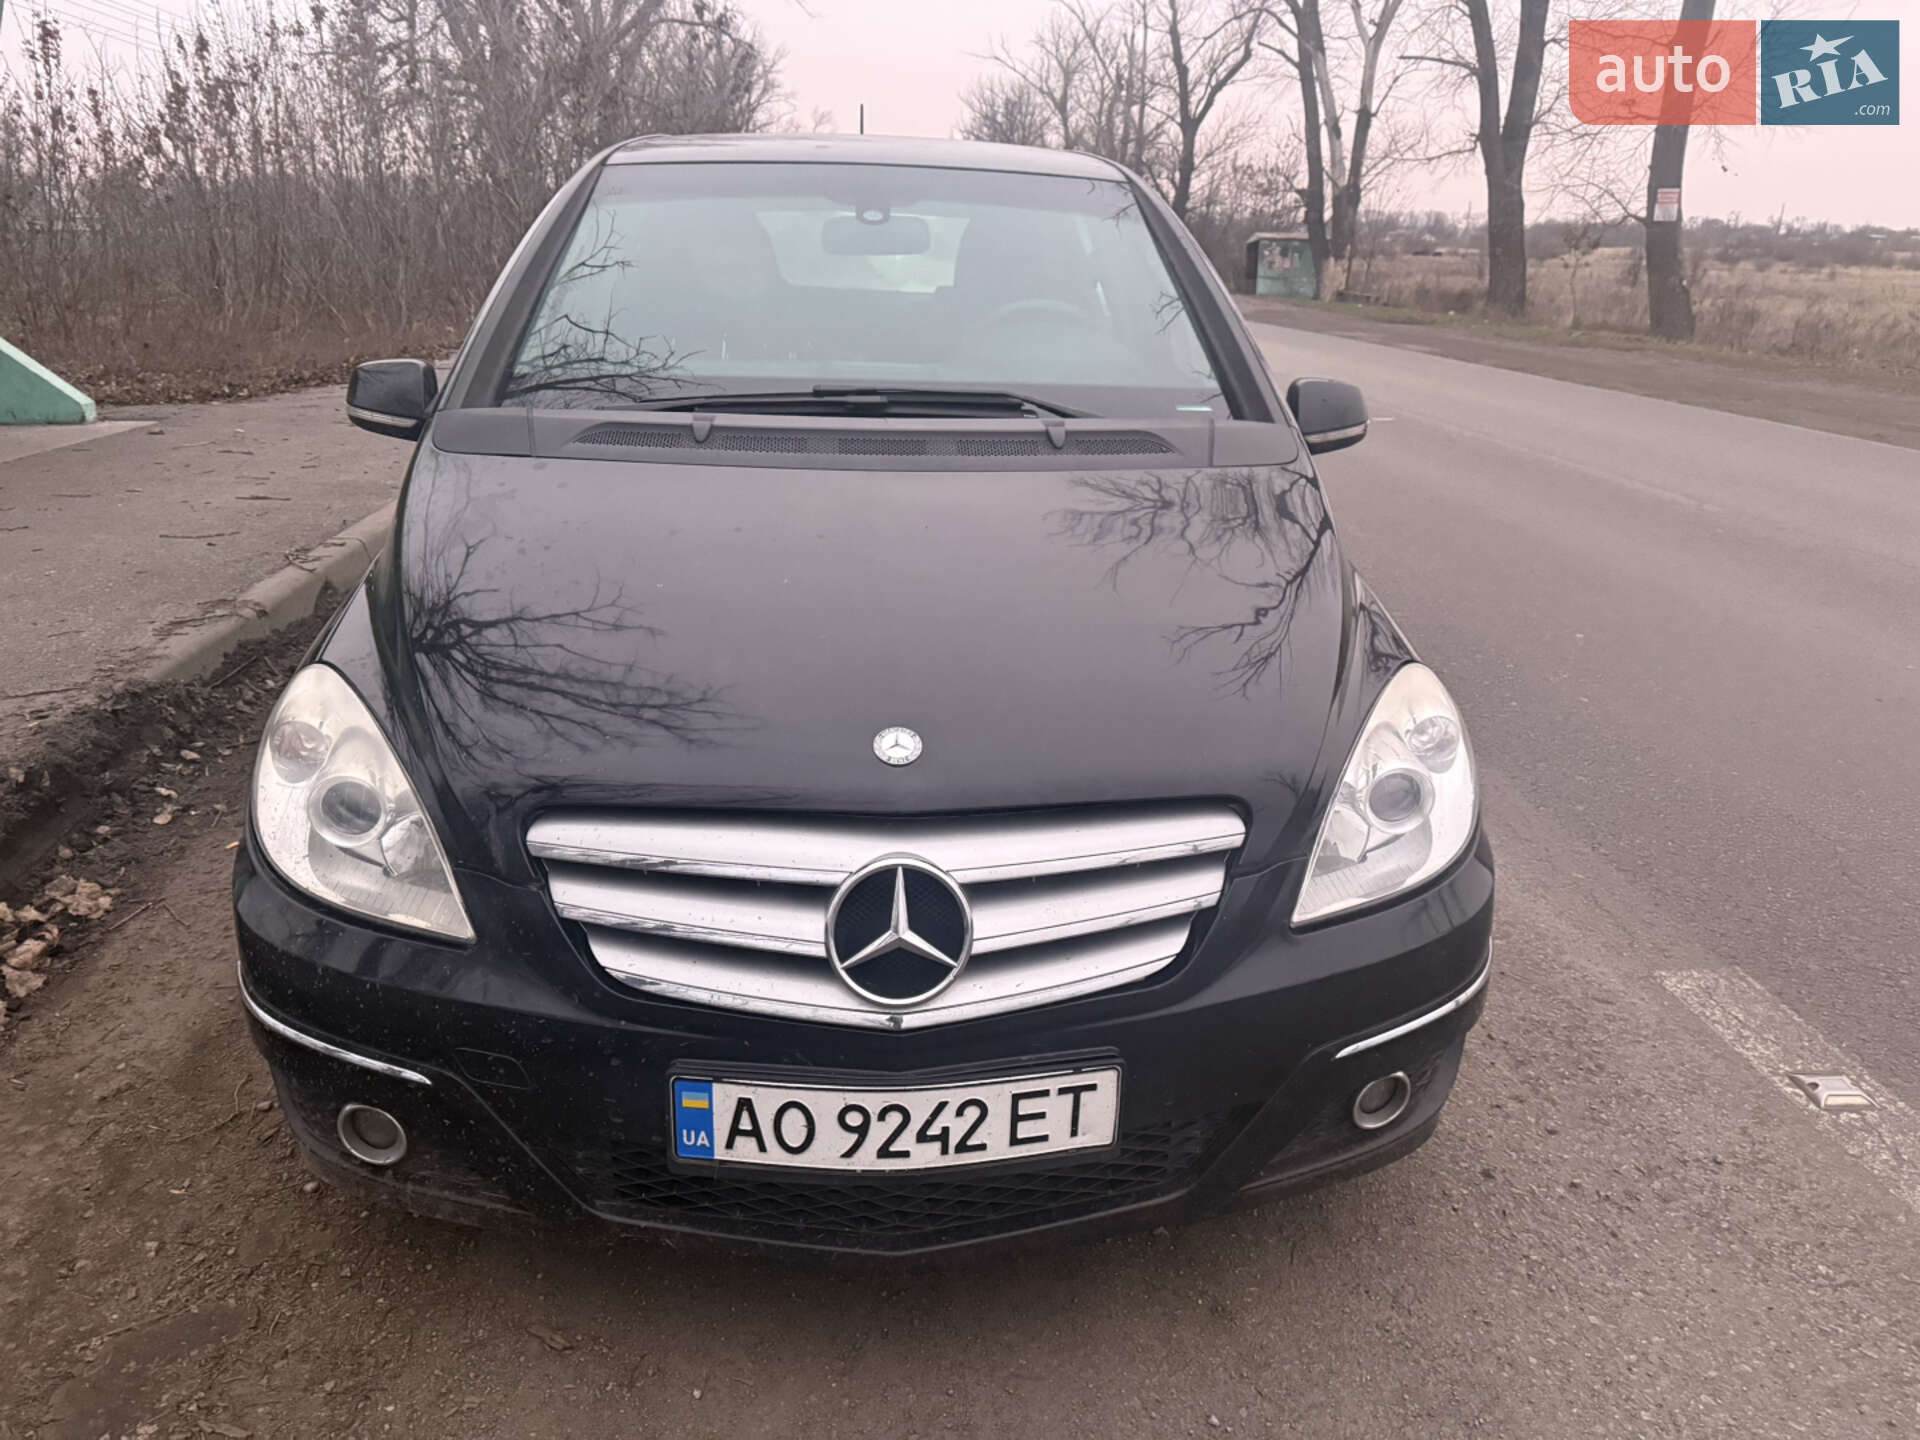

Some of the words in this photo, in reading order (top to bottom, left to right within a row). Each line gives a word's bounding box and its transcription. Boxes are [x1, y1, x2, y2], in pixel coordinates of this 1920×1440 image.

[682, 1129, 710, 1148] UA
[725, 1096, 816, 1155] AO
[837, 1098, 988, 1159] 9242
[1009, 1083, 1098, 1147] ET
